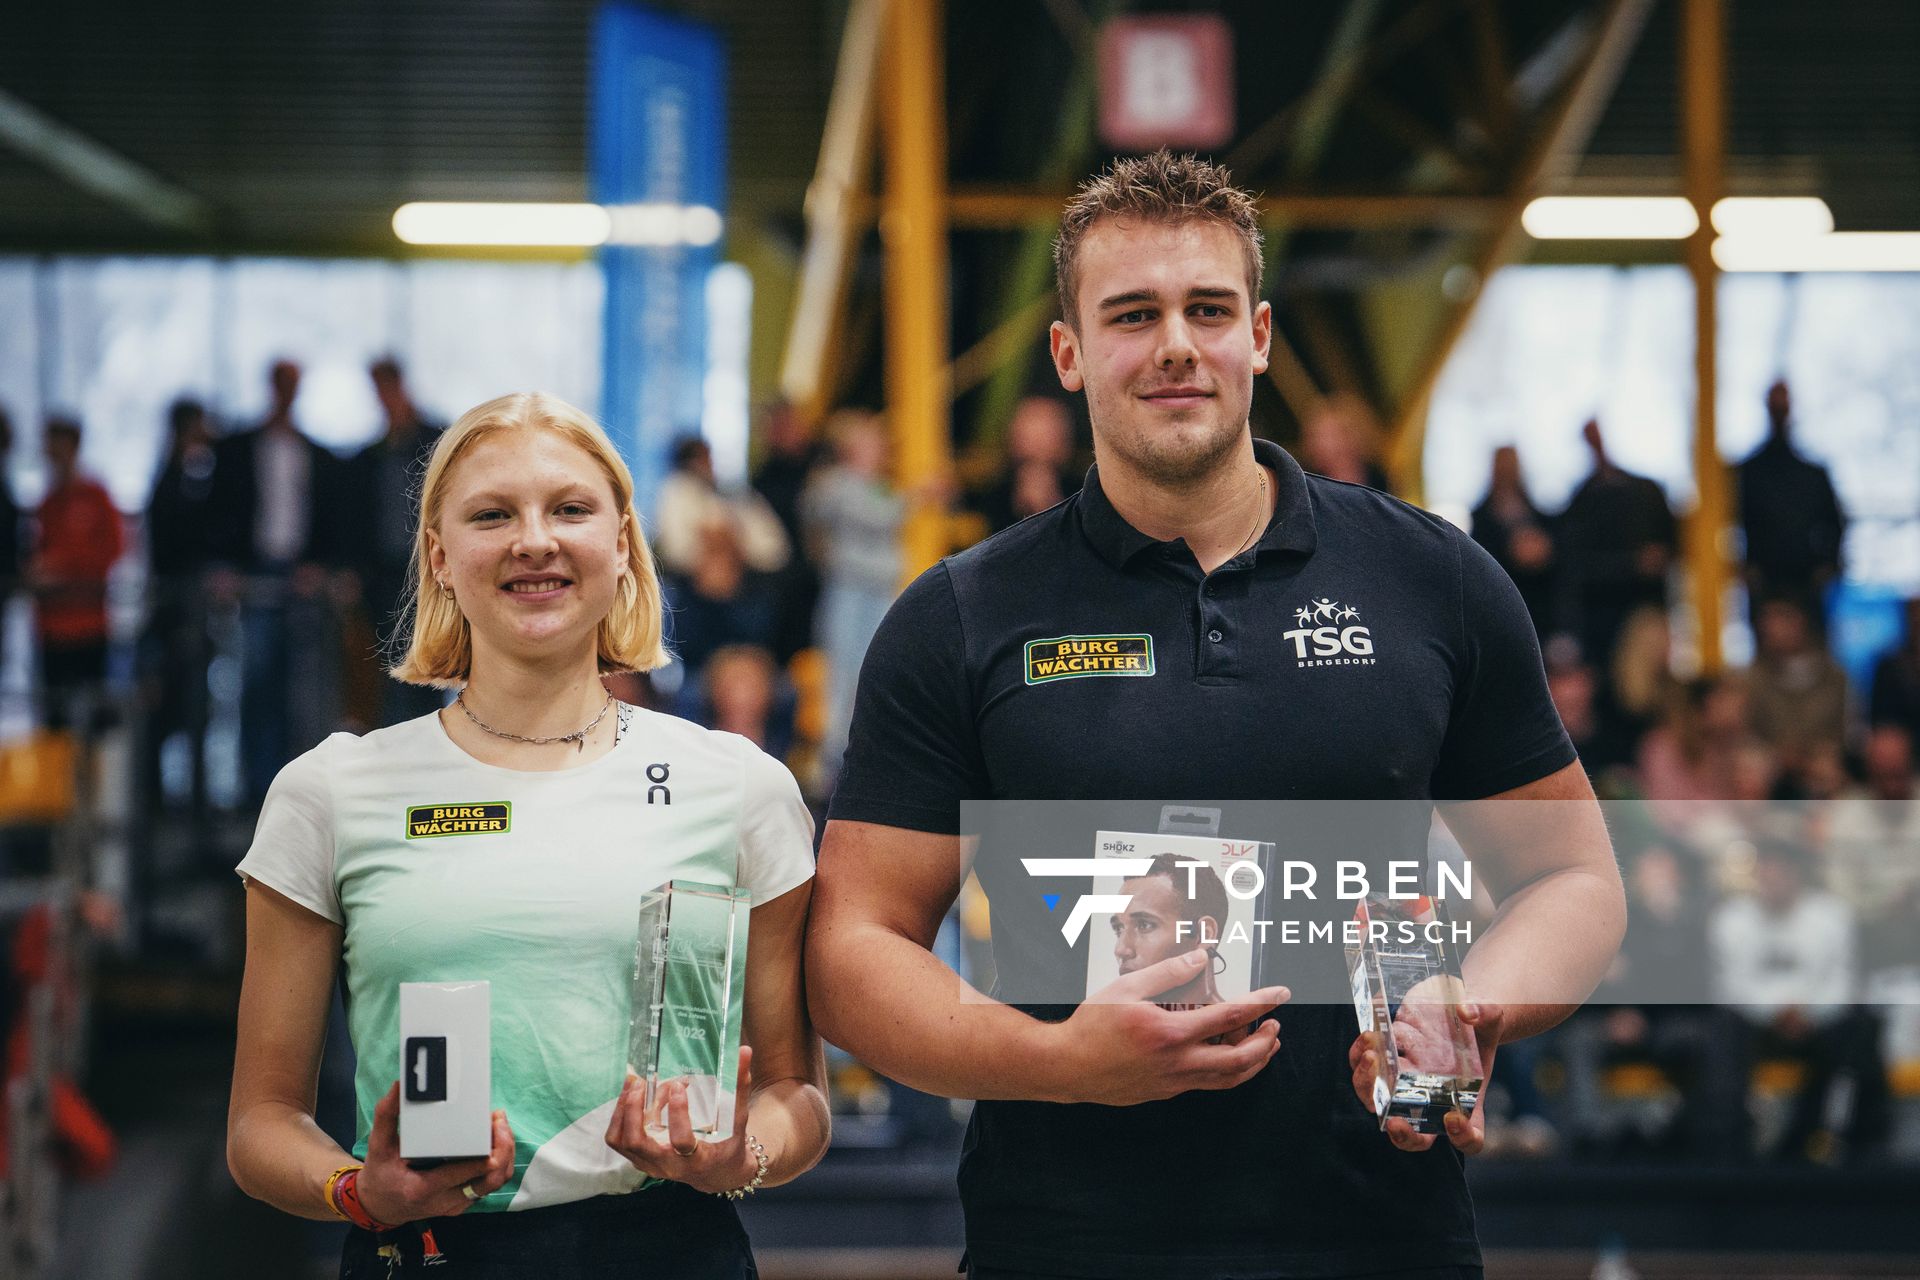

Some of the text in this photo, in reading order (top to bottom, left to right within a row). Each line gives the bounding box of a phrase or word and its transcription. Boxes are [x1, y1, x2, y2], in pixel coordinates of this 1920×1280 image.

[1057, 641, 1118, 656] BURG
[1283, 626, 1374, 658] TSG
[1036, 655, 1140, 675] WÄCHTER
[1298, 658, 1376, 668] BERGEDORF
[433, 807, 485, 819] BURG
[415, 819, 501, 834] WÄCHTER
[1103, 842, 1135, 853] SHOKZ
[676, 1025, 706, 1041] 2022
